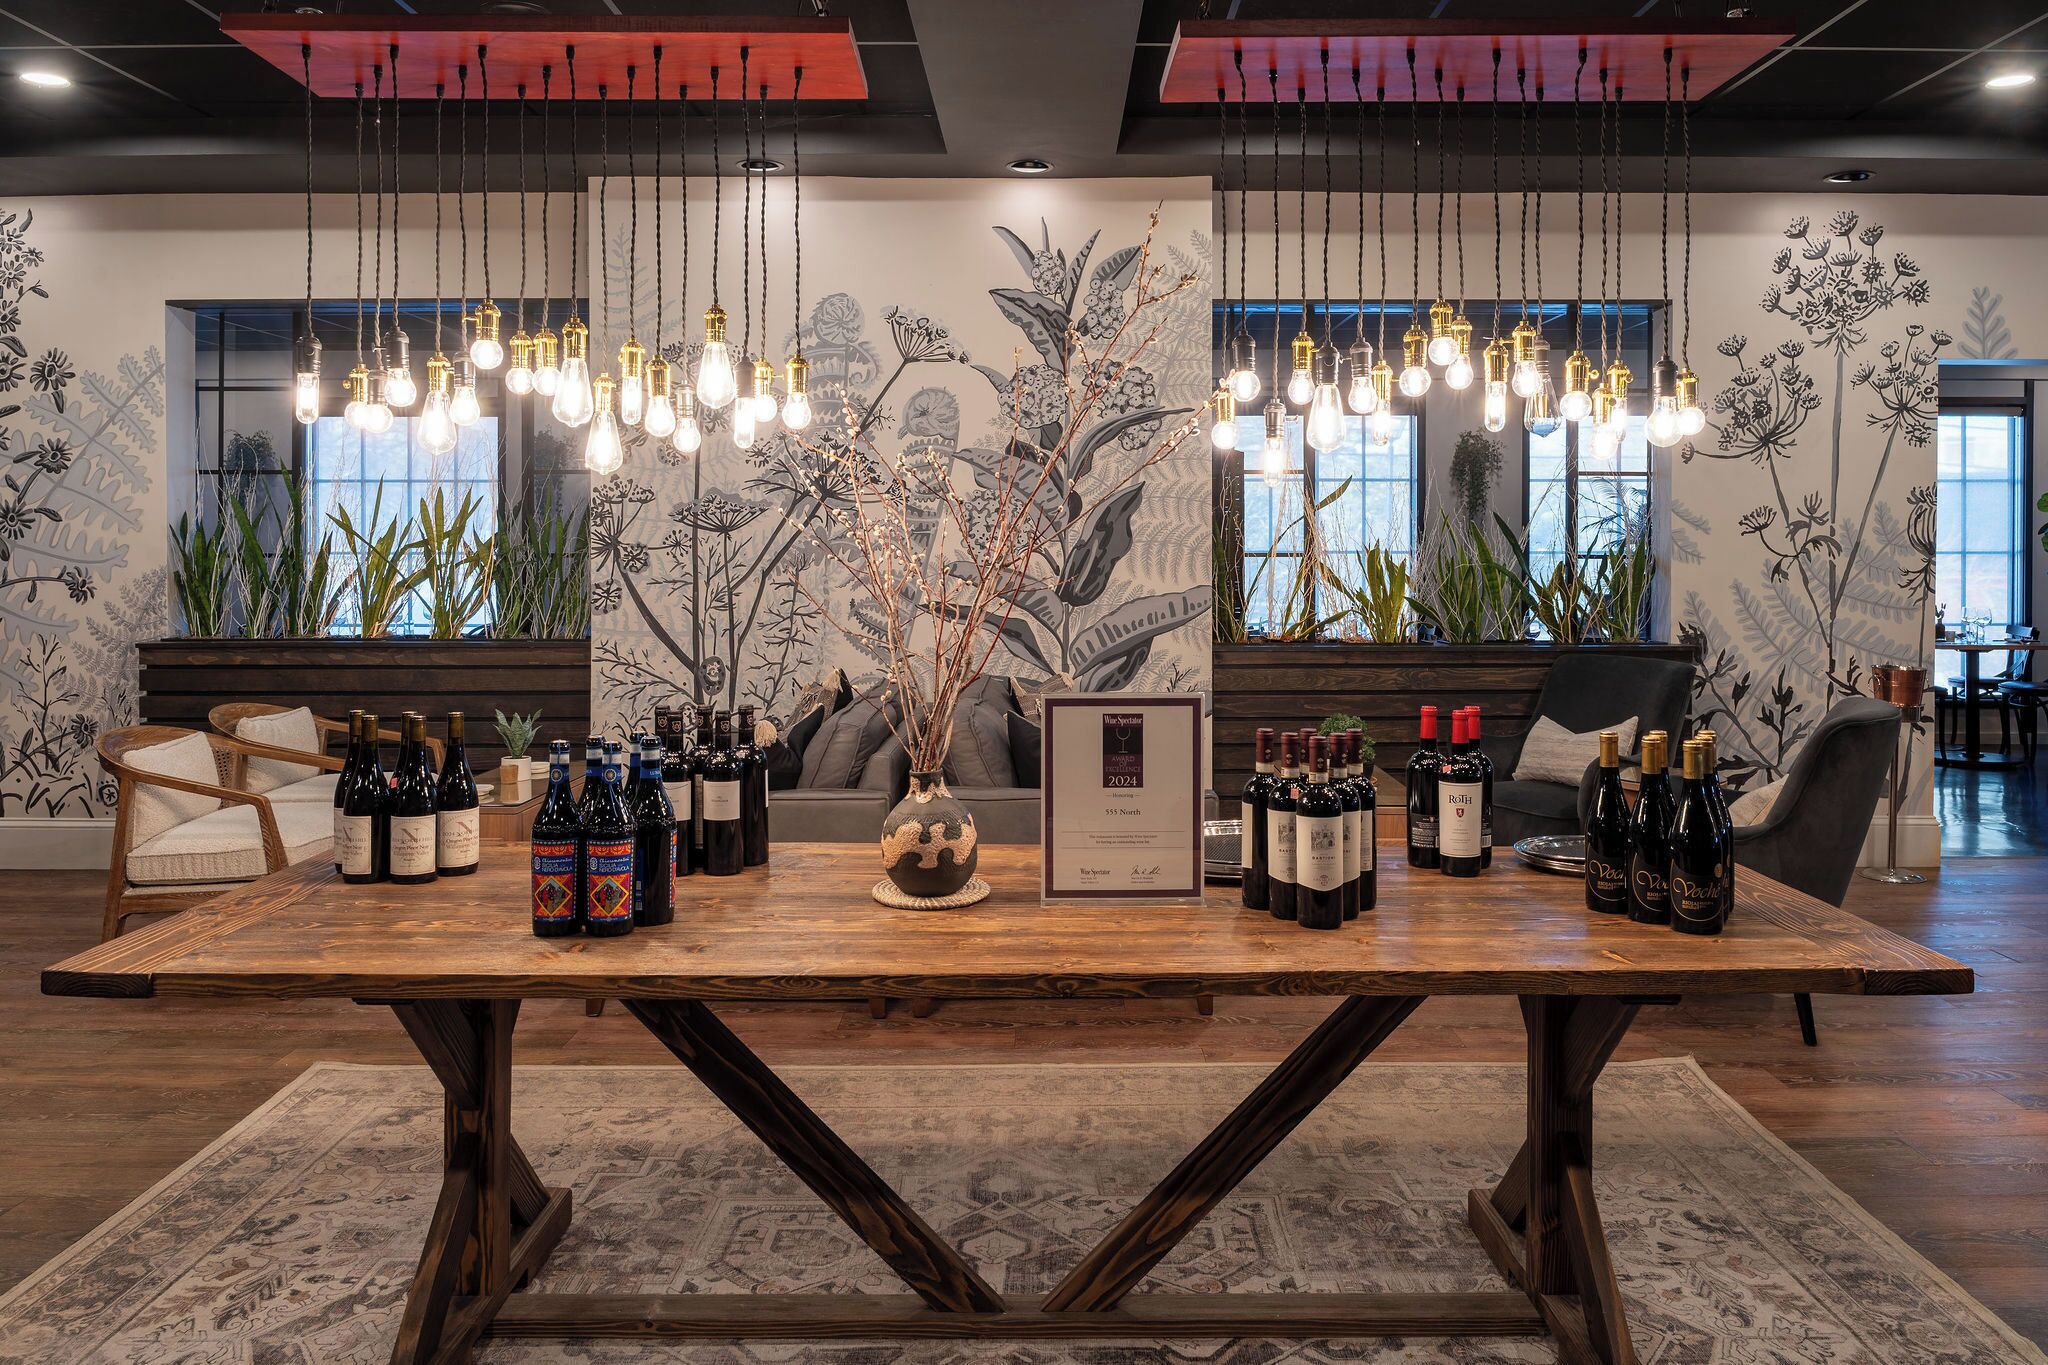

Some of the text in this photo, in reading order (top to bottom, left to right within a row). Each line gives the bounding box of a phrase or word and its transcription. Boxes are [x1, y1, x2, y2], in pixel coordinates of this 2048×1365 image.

[1104, 715, 1142, 726] Wine Spectator
[1108, 775, 1138, 786] 2024
[1119, 808, 1141, 816] North
[1090, 867, 1111, 877] Spectator
